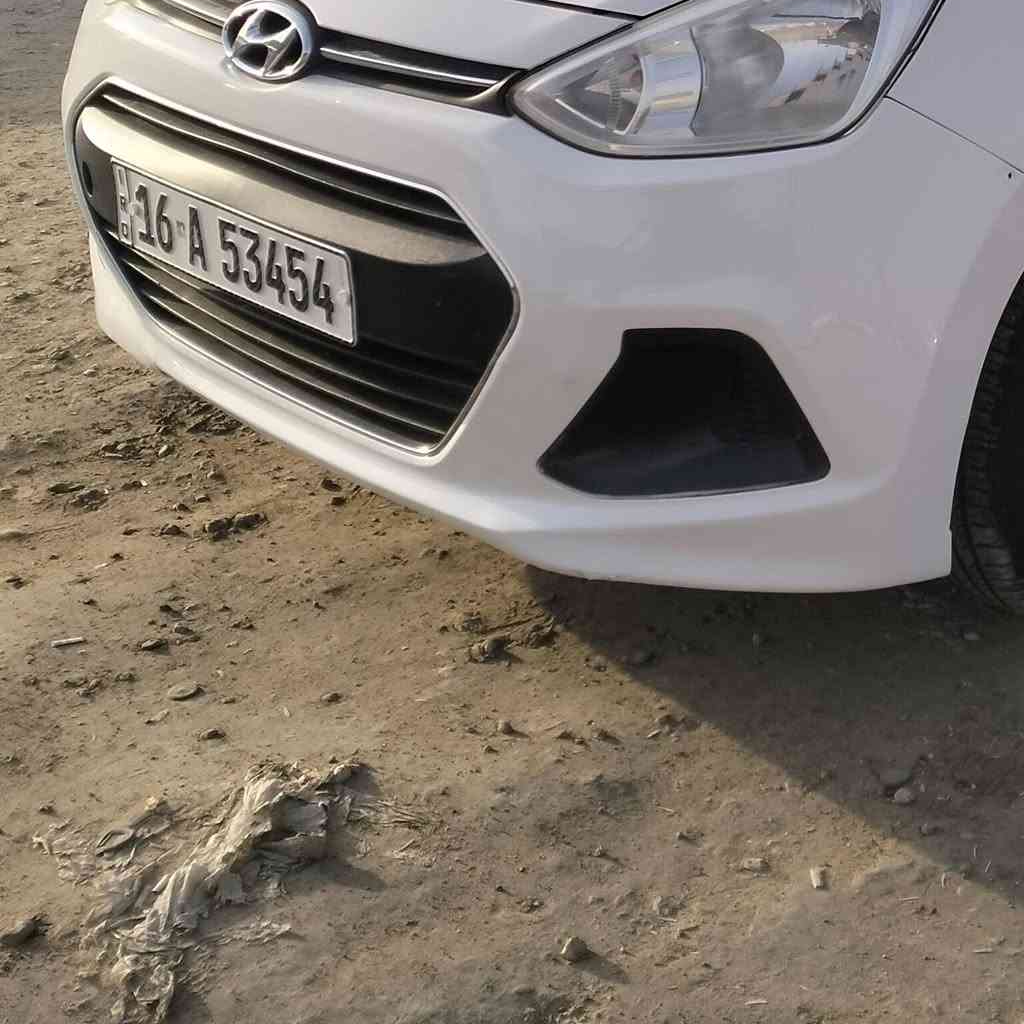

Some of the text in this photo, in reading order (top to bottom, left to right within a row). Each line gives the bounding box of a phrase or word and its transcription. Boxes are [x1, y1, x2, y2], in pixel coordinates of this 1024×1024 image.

[135, 183, 335, 325] 16 A 53454
